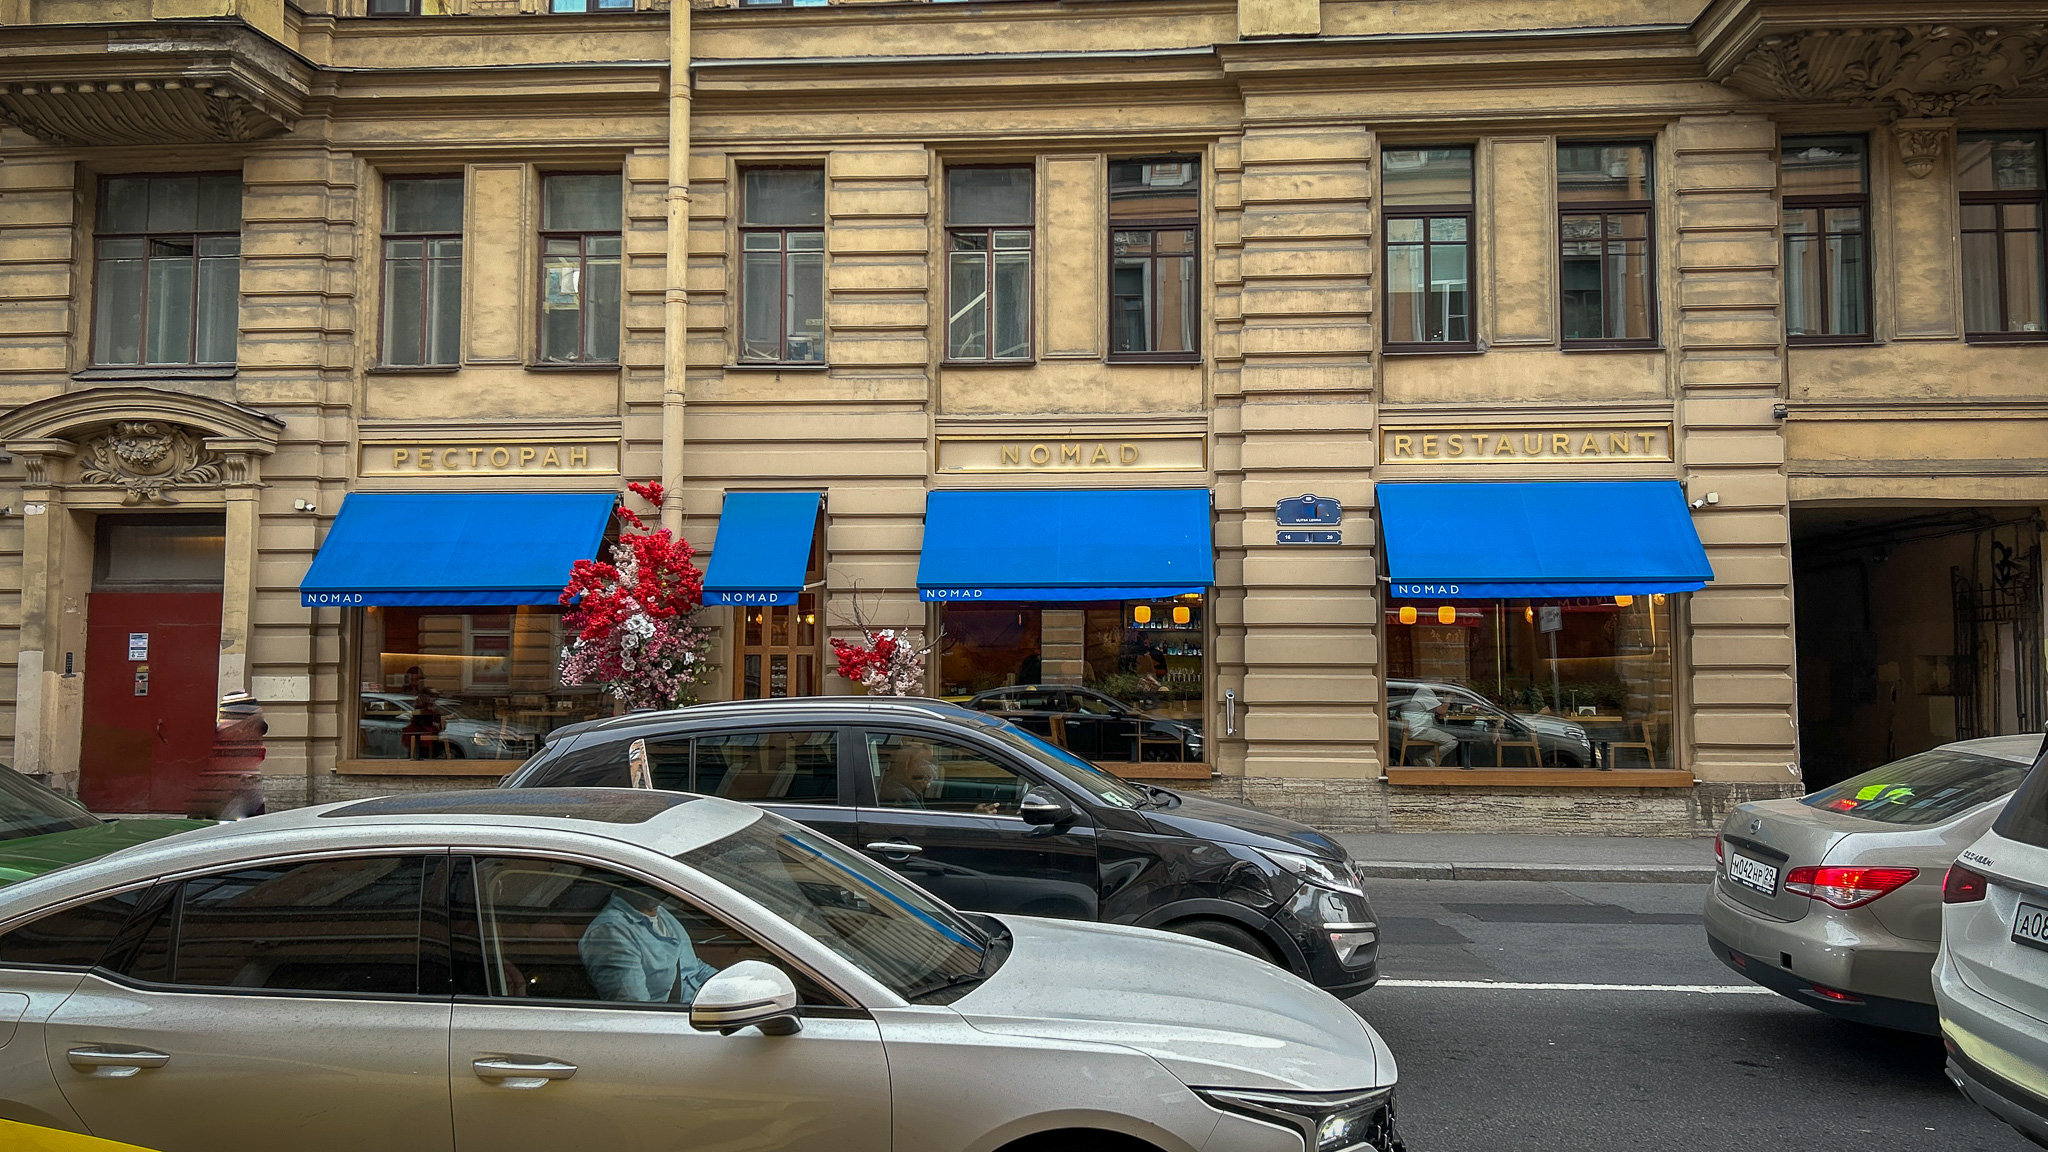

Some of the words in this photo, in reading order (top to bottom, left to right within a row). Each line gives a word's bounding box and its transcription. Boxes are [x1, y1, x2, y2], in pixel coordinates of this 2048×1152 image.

[1394, 432, 1656, 456] RESTAURANT
[393, 447, 588, 469] РЕСТОРАН
[1001, 443, 1139, 465] NOMAD
[926, 589, 983, 598] NOMAD
[1399, 584, 1459, 594] NOMAD
[307, 593, 363, 603] NOMAD
[722, 592, 778, 603] NOMAD
